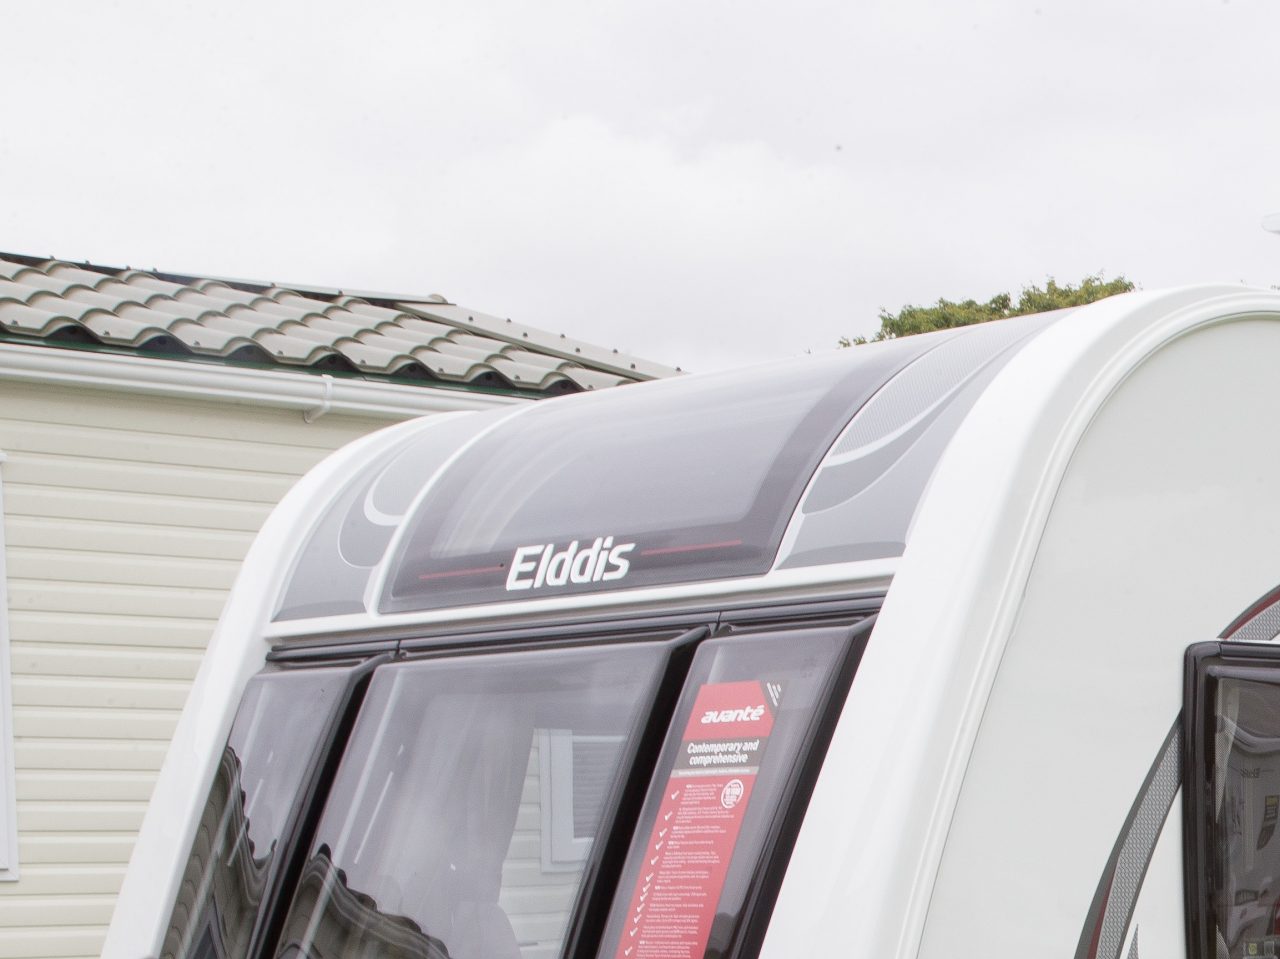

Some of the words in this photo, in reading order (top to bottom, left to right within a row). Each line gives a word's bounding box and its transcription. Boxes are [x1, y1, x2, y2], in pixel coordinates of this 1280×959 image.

[506, 536, 636, 591] Elddis
[701, 704, 765, 724] avanté
[687, 741, 743, 755] Contemporary
[742, 739, 760, 752] and
[689, 752, 749, 766] comprehensive
